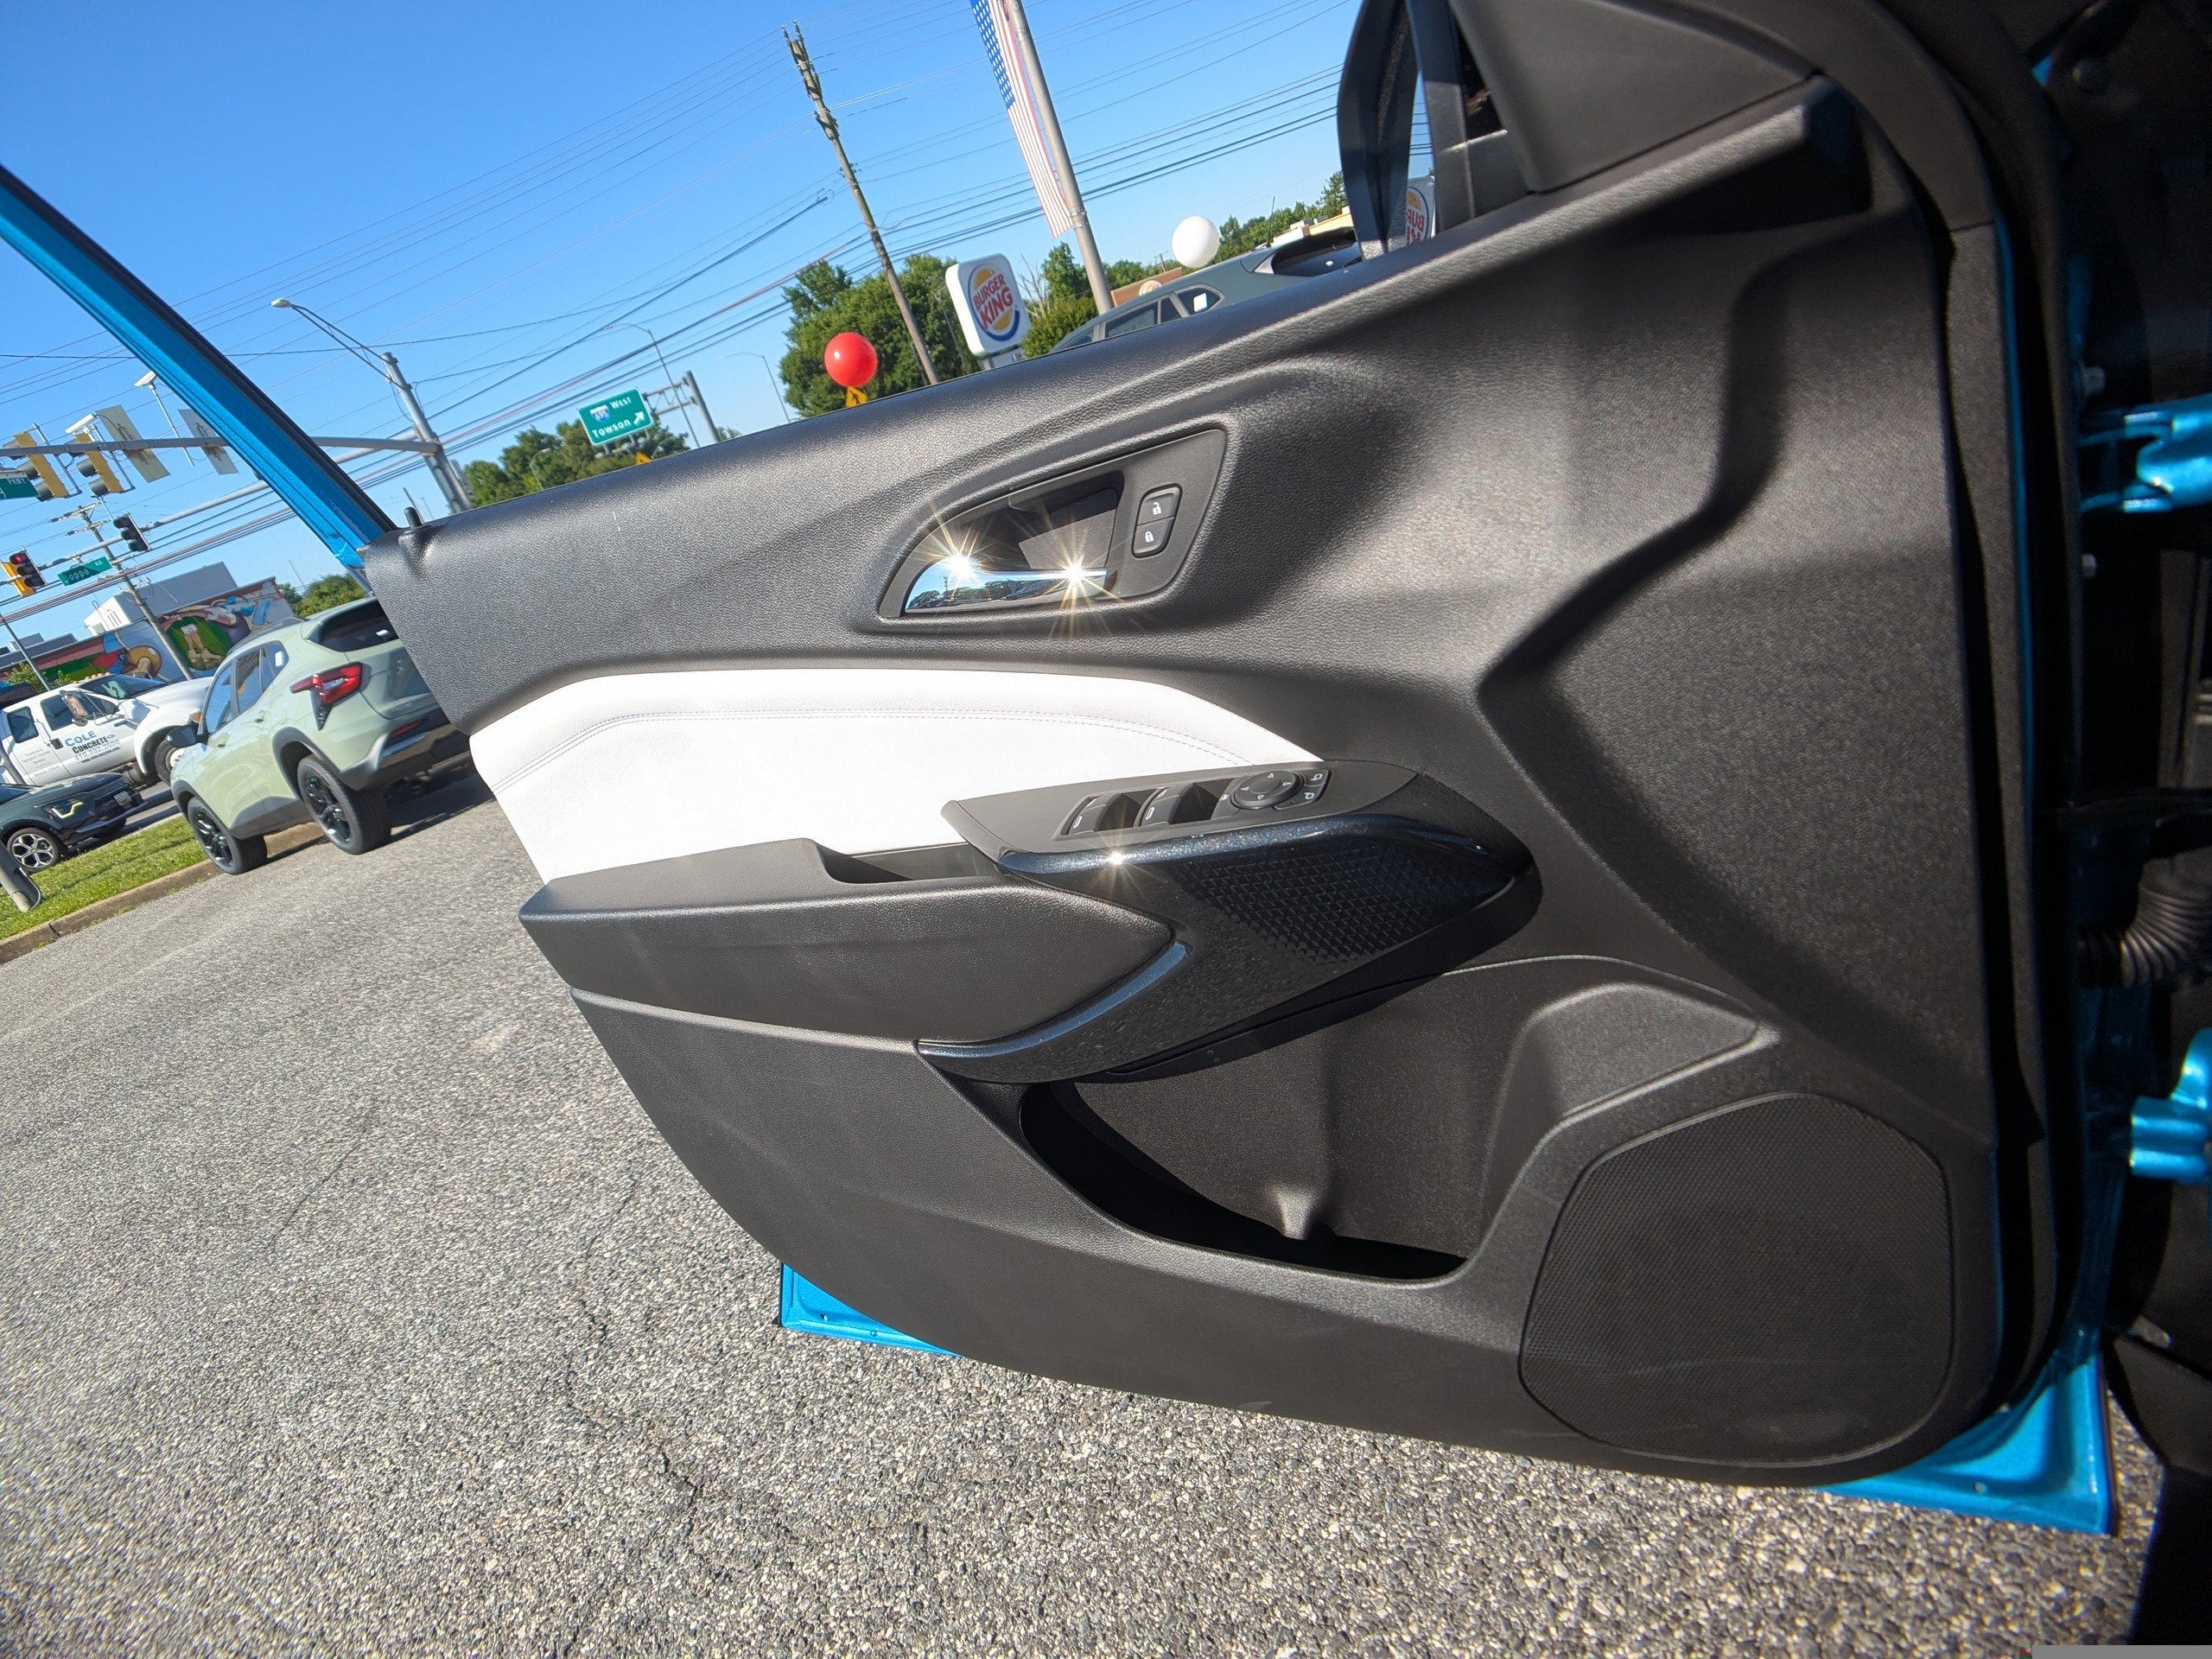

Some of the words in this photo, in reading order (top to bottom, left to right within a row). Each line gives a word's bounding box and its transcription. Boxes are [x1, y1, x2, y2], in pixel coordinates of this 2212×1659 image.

[973, 274, 1006, 311] BURGER
[980, 286, 1014, 331] KING
[64, 569, 90, 582] Joppa
[65, 731, 97, 747] COLE
[72, 736, 108, 753] CONCRETE
